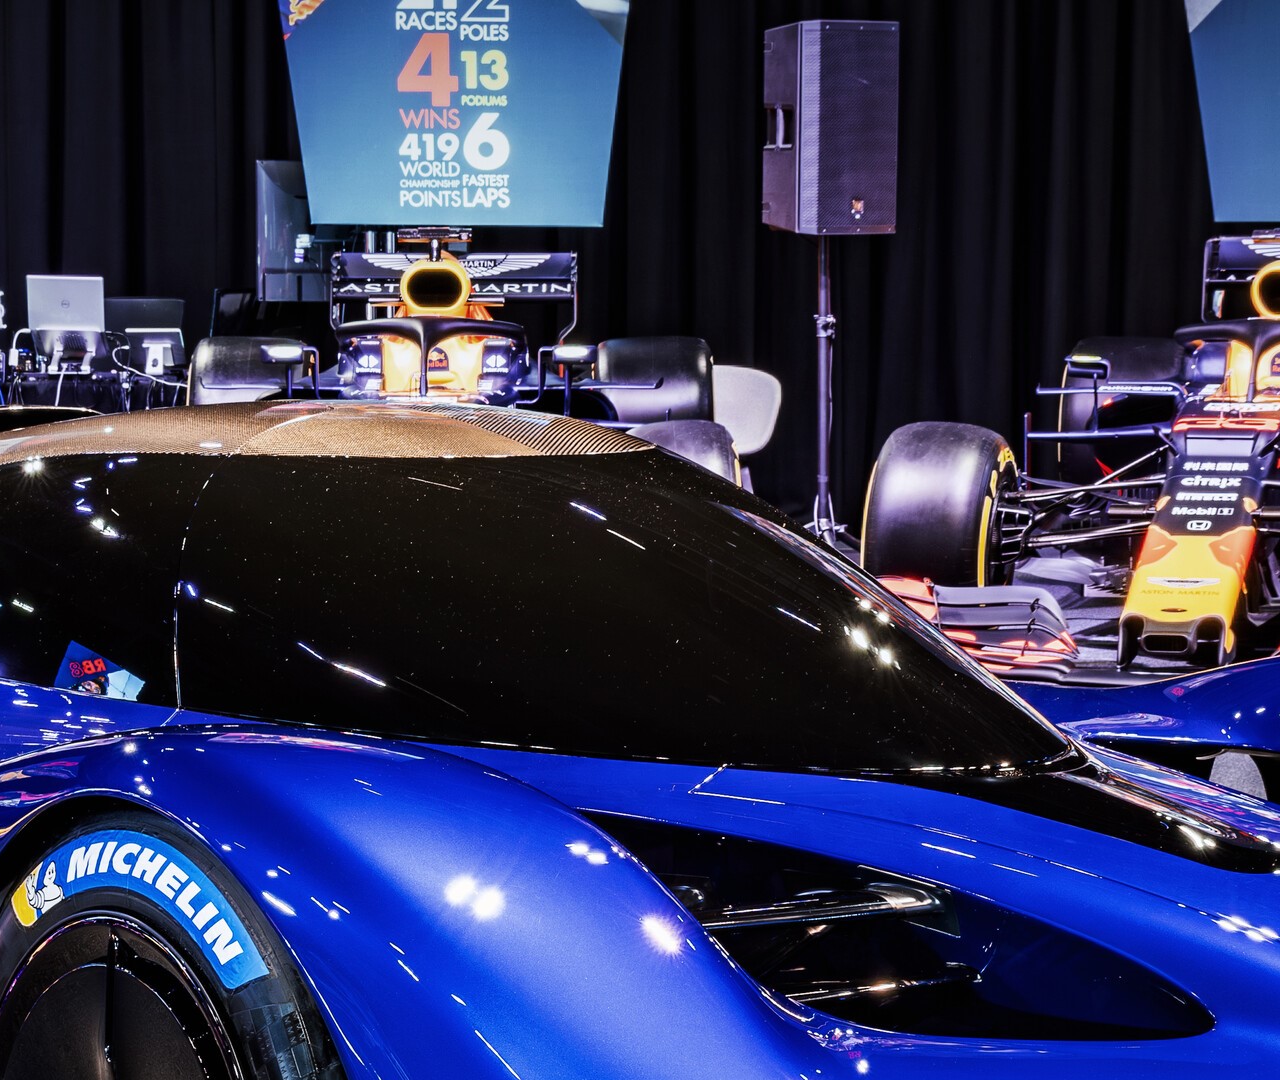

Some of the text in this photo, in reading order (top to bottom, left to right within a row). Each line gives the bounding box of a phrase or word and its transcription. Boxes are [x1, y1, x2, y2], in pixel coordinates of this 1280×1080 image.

[395, 11, 458, 30] RACES
[460, 24, 509, 41] POLES
[397, 32, 459, 107] 4
[460, 50, 509, 91] 13
[461, 95, 508, 107] PODIUMS
[399, 108, 461, 130] WINS
[399, 133, 460, 161] 419
[463, 112, 510, 171] 6
[399, 161, 460, 178] WORLD
[400, 179, 460, 189] CHAMPIONSHIP
[463, 174, 509, 187] FASTEST
[400, 190, 461, 208] POINTS
[463, 187, 511, 208] LAPS
[1171, 507, 1216, 516] Mobil
[1140, 588, 1174, 596] ASTON
[66, 840, 245, 967] MICHELIN
